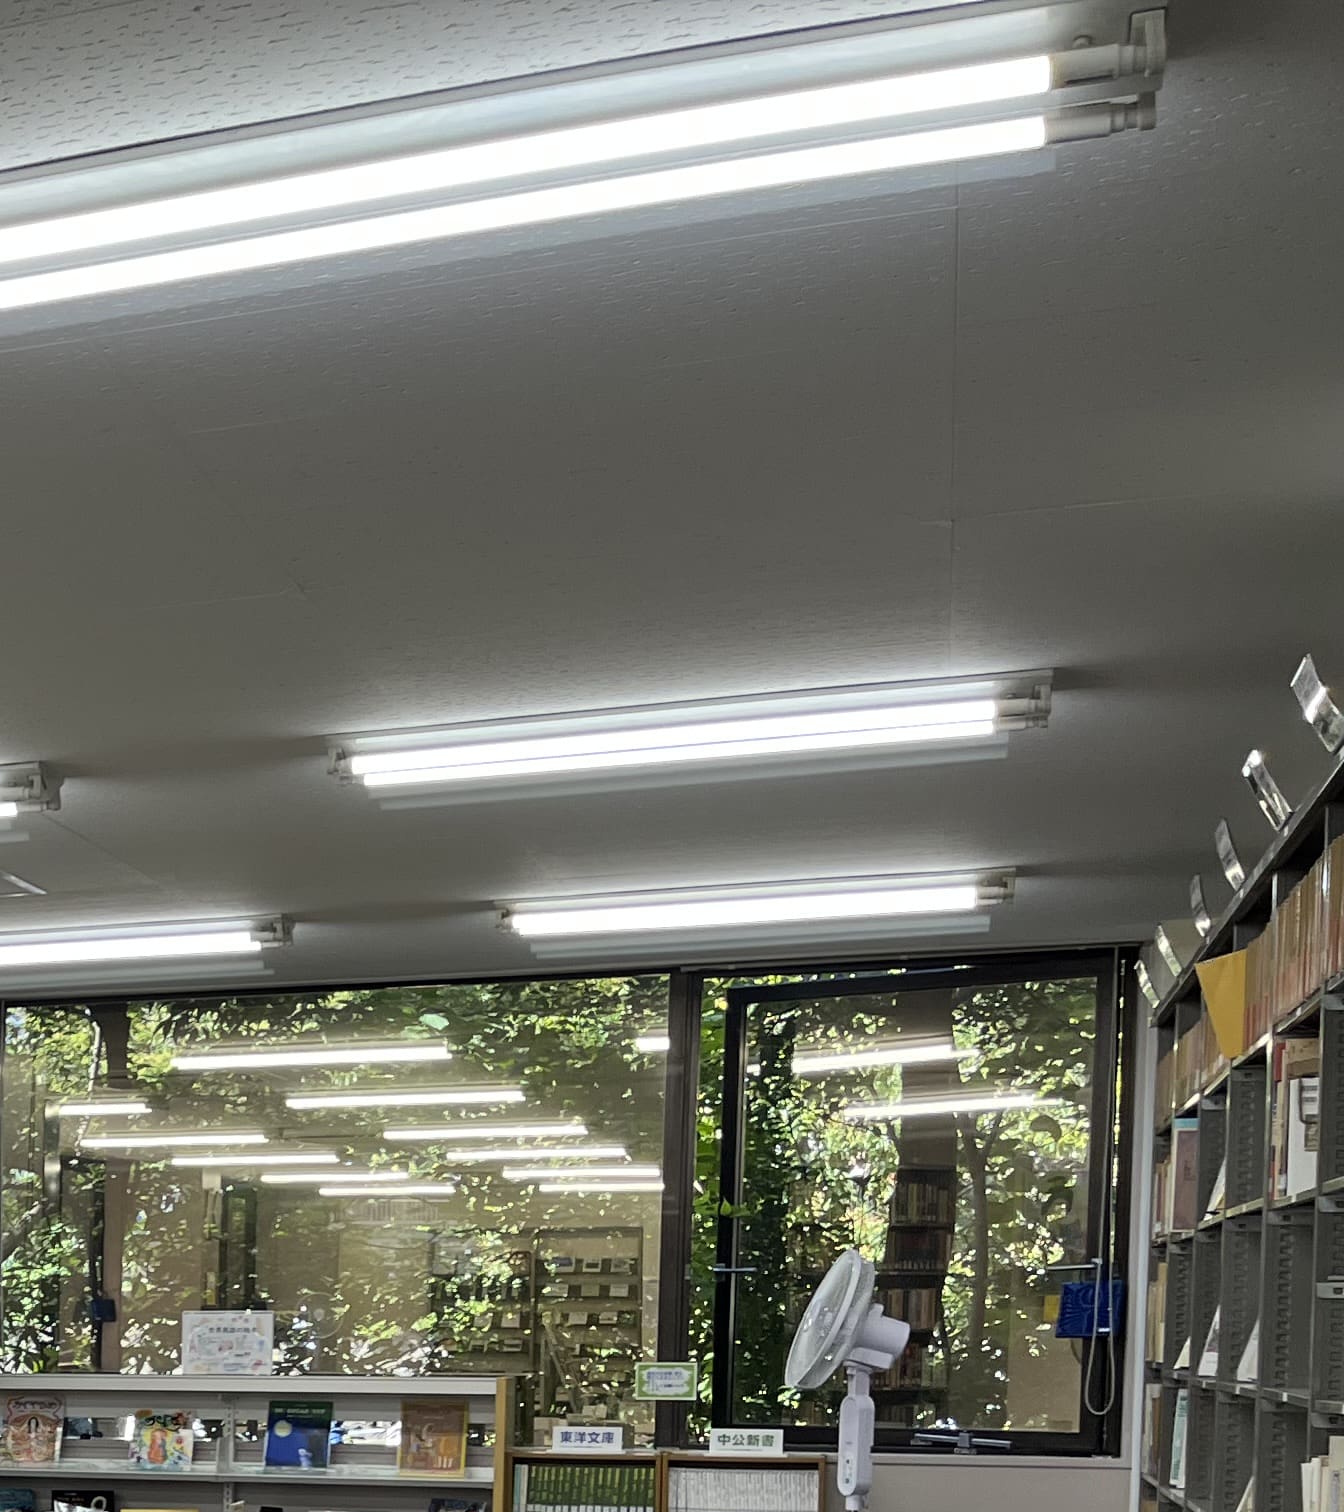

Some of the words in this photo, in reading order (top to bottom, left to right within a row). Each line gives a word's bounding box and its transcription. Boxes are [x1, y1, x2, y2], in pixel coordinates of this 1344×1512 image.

[560, 1431, 615, 1444] 東洋文庫
[717, 1434, 775, 1447] 中公新書
